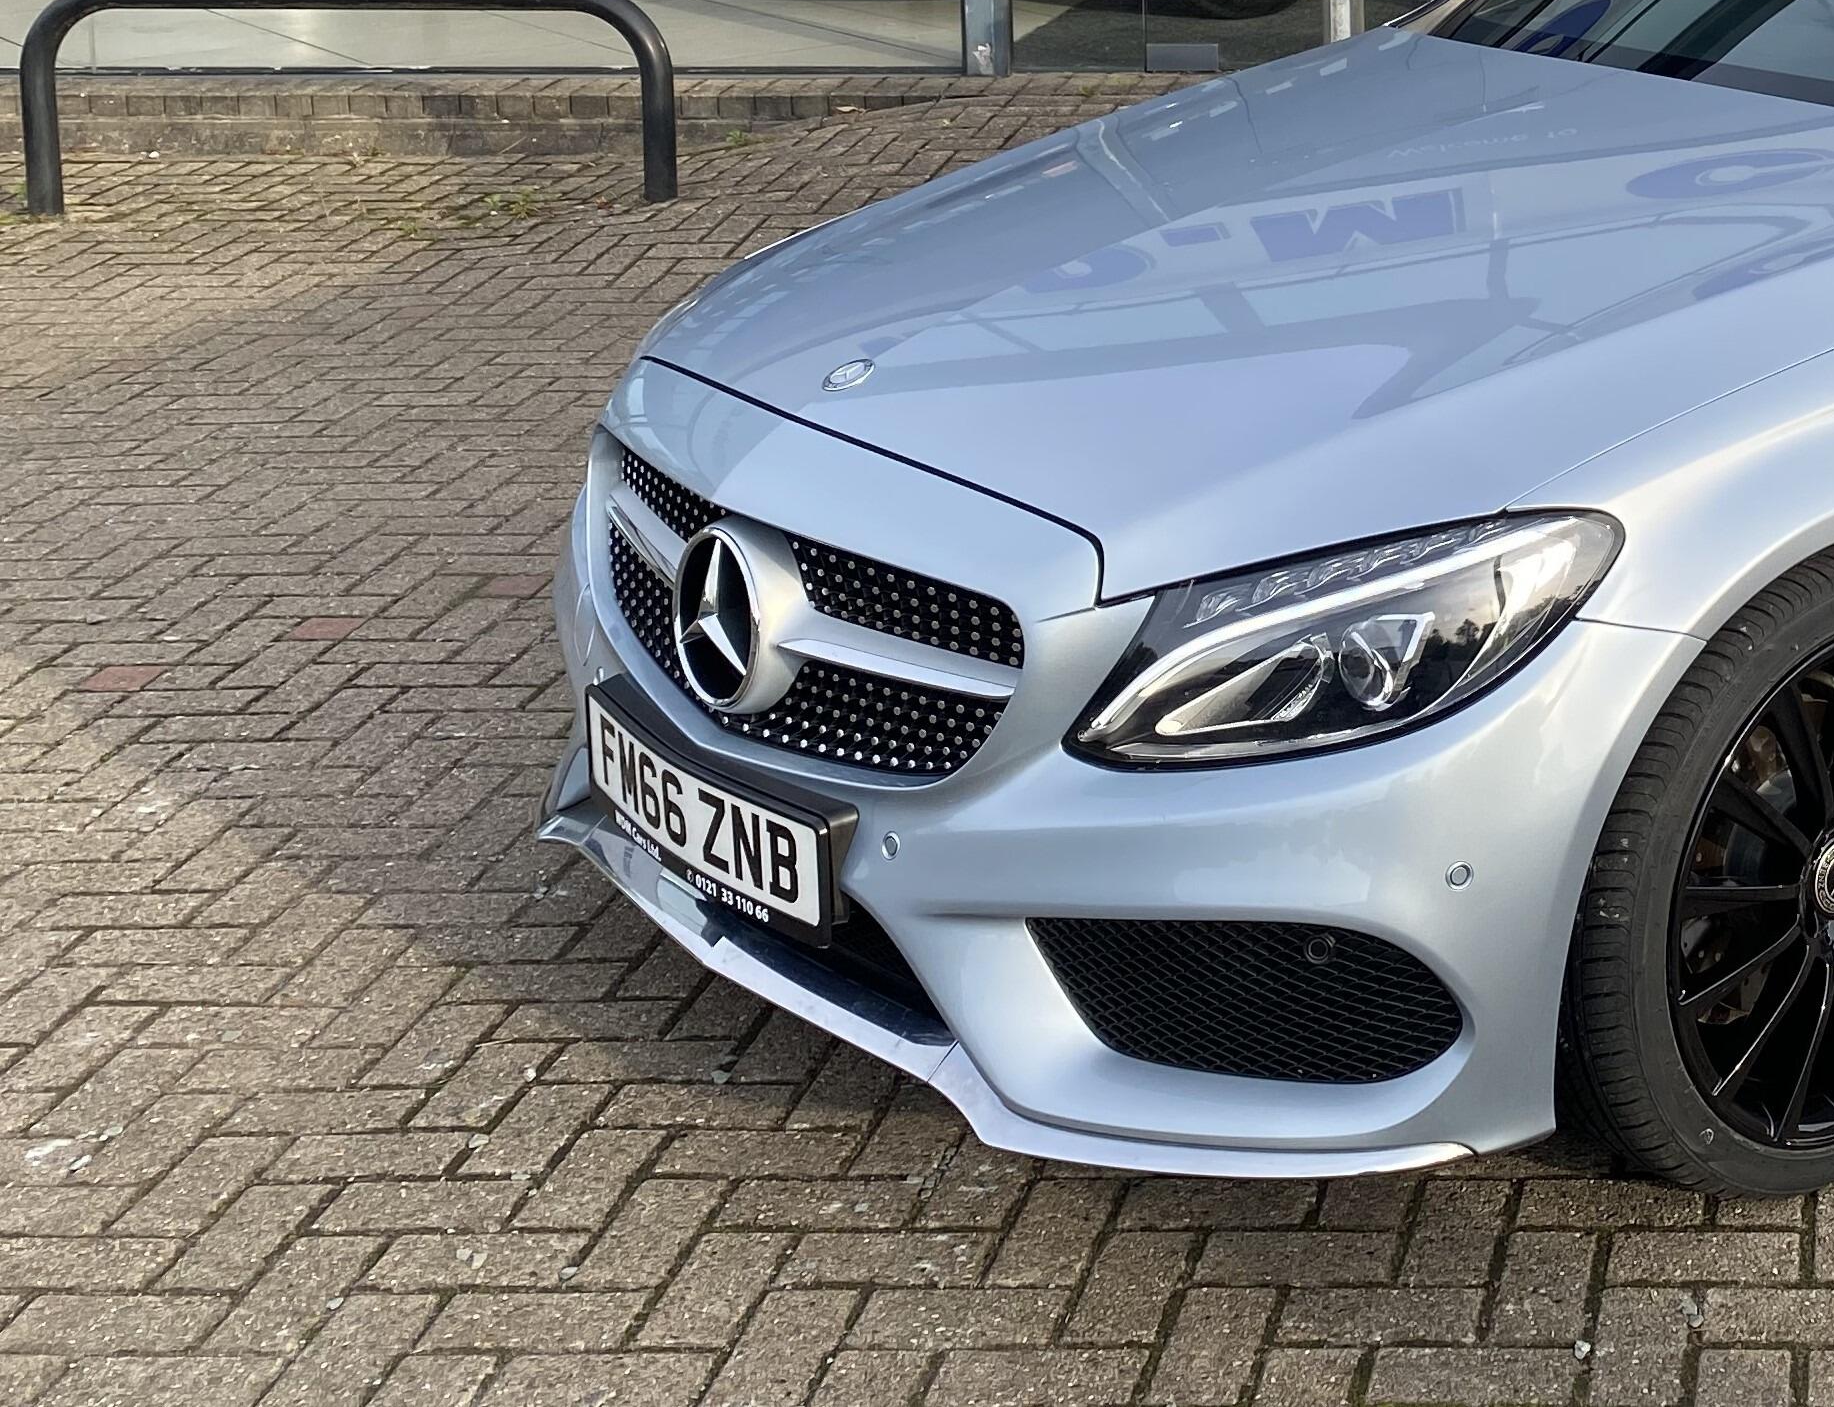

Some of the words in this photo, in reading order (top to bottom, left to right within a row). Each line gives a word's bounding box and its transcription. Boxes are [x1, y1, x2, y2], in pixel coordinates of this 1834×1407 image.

[600, 713, 687, 848] FM66
[698, 788, 799, 904] ZNB
[632, 825, 647, 850] Cars
[647, 841, 662, 862] Ltd.
[695, 873, 717, 897] 0121
[721, 887, 734, 906] 33
[735, 895, 754, 915] 110
[755, 906, 769, 923] 66
